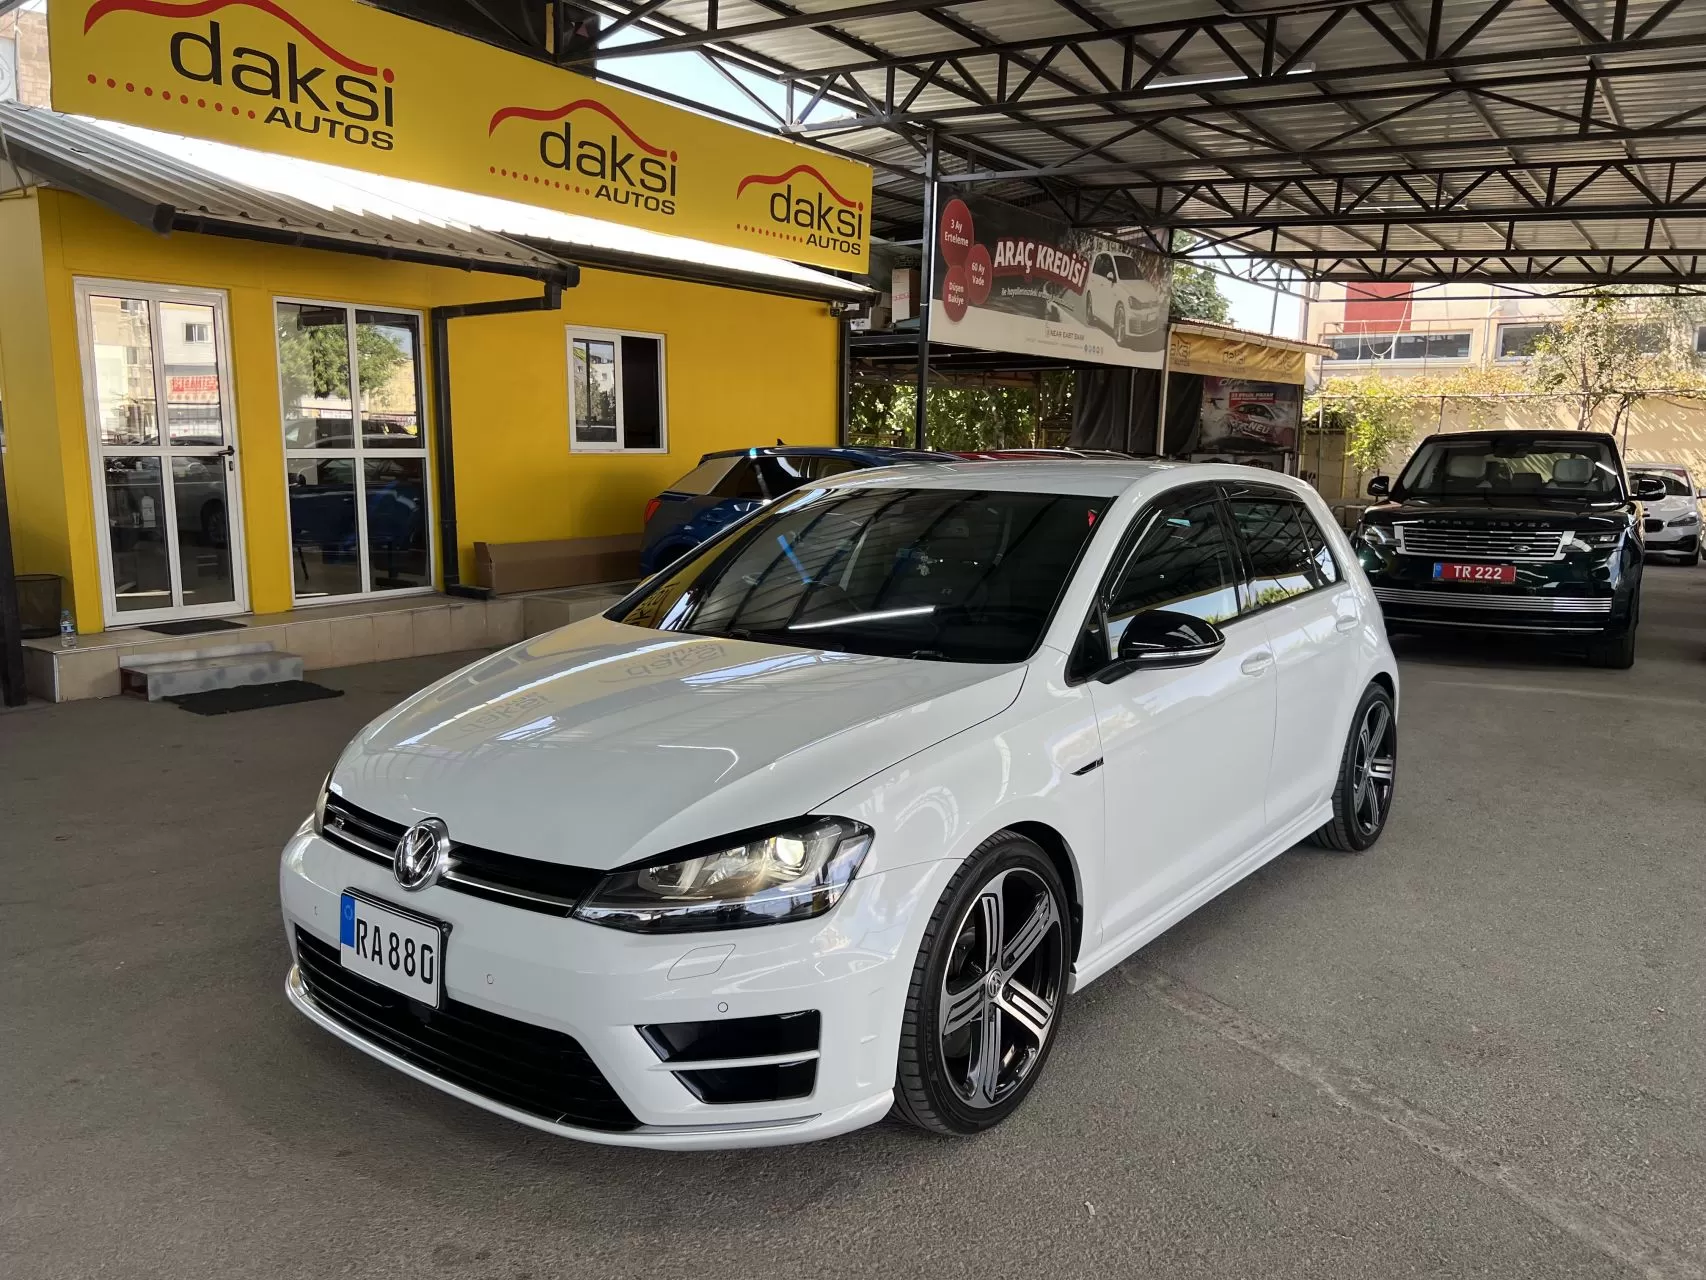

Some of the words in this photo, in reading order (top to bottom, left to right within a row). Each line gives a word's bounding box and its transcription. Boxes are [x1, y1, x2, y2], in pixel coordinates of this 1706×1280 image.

[170, 20, 395, 128] daksi
[263, 106, 394, 151] AUTOS
[540, 121, 678, 197] daksi
[594, 184, 676, 216] AUTOS
[770, 184, 864, 240] daksi
[950, 219, 955, 229] 3
[955, 220, 963, 233] Ay
[806, 233, 861, 256] AUTOS
[944, 231, 969, 247] Erteleme
[971, 262, 978, 272] 60
[978, 263, 985, 276] Ay
[993, 241, 1035, 274] ARAÇ
[1035, 244, 1087, 288] KREDİSİ
[948, 282, 965, 293] Düşen
[972, 275, 985, 286] Vade
[947, 294, 965, 306] Bakiye
[1453, 565, 1471, 578] TR
[1474, 567, 1502, 580] 222
